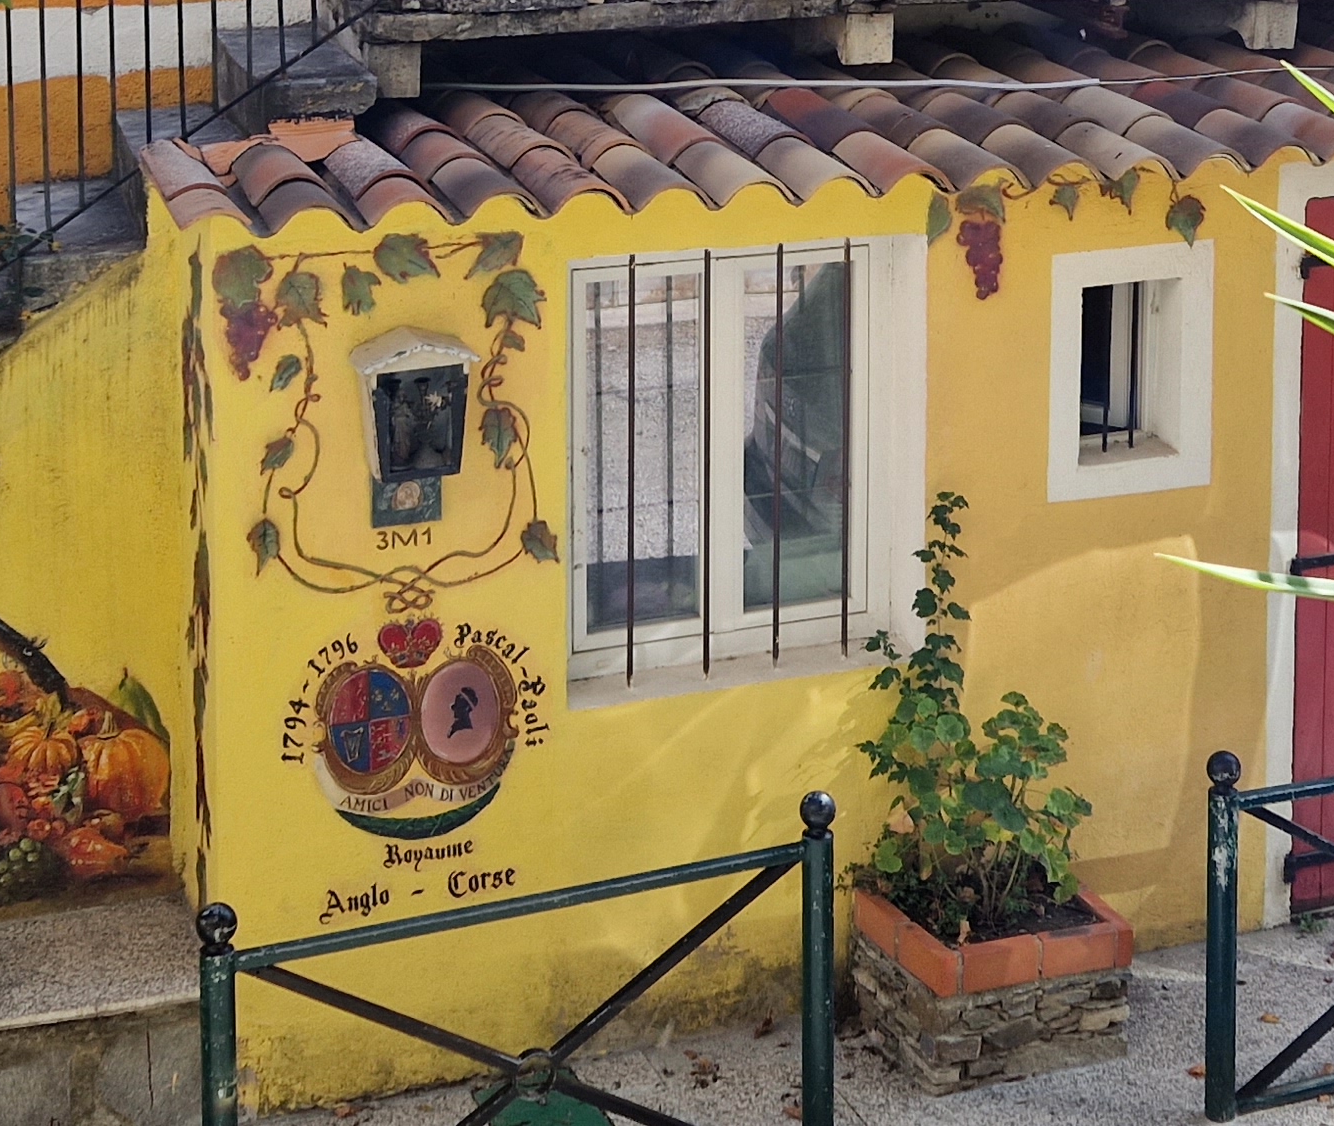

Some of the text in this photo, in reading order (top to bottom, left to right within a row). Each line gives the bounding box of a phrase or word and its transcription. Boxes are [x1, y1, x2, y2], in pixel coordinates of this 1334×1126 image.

[340, 795, 389, 812] AMICI
[404, 782, 435, 802] NON
[440, 787, 454, 802] DI
[383, 838, 474, 872] Royaume
[319, 882, 390, 924] Anglo
[447, 867, 516, 898] Corse
